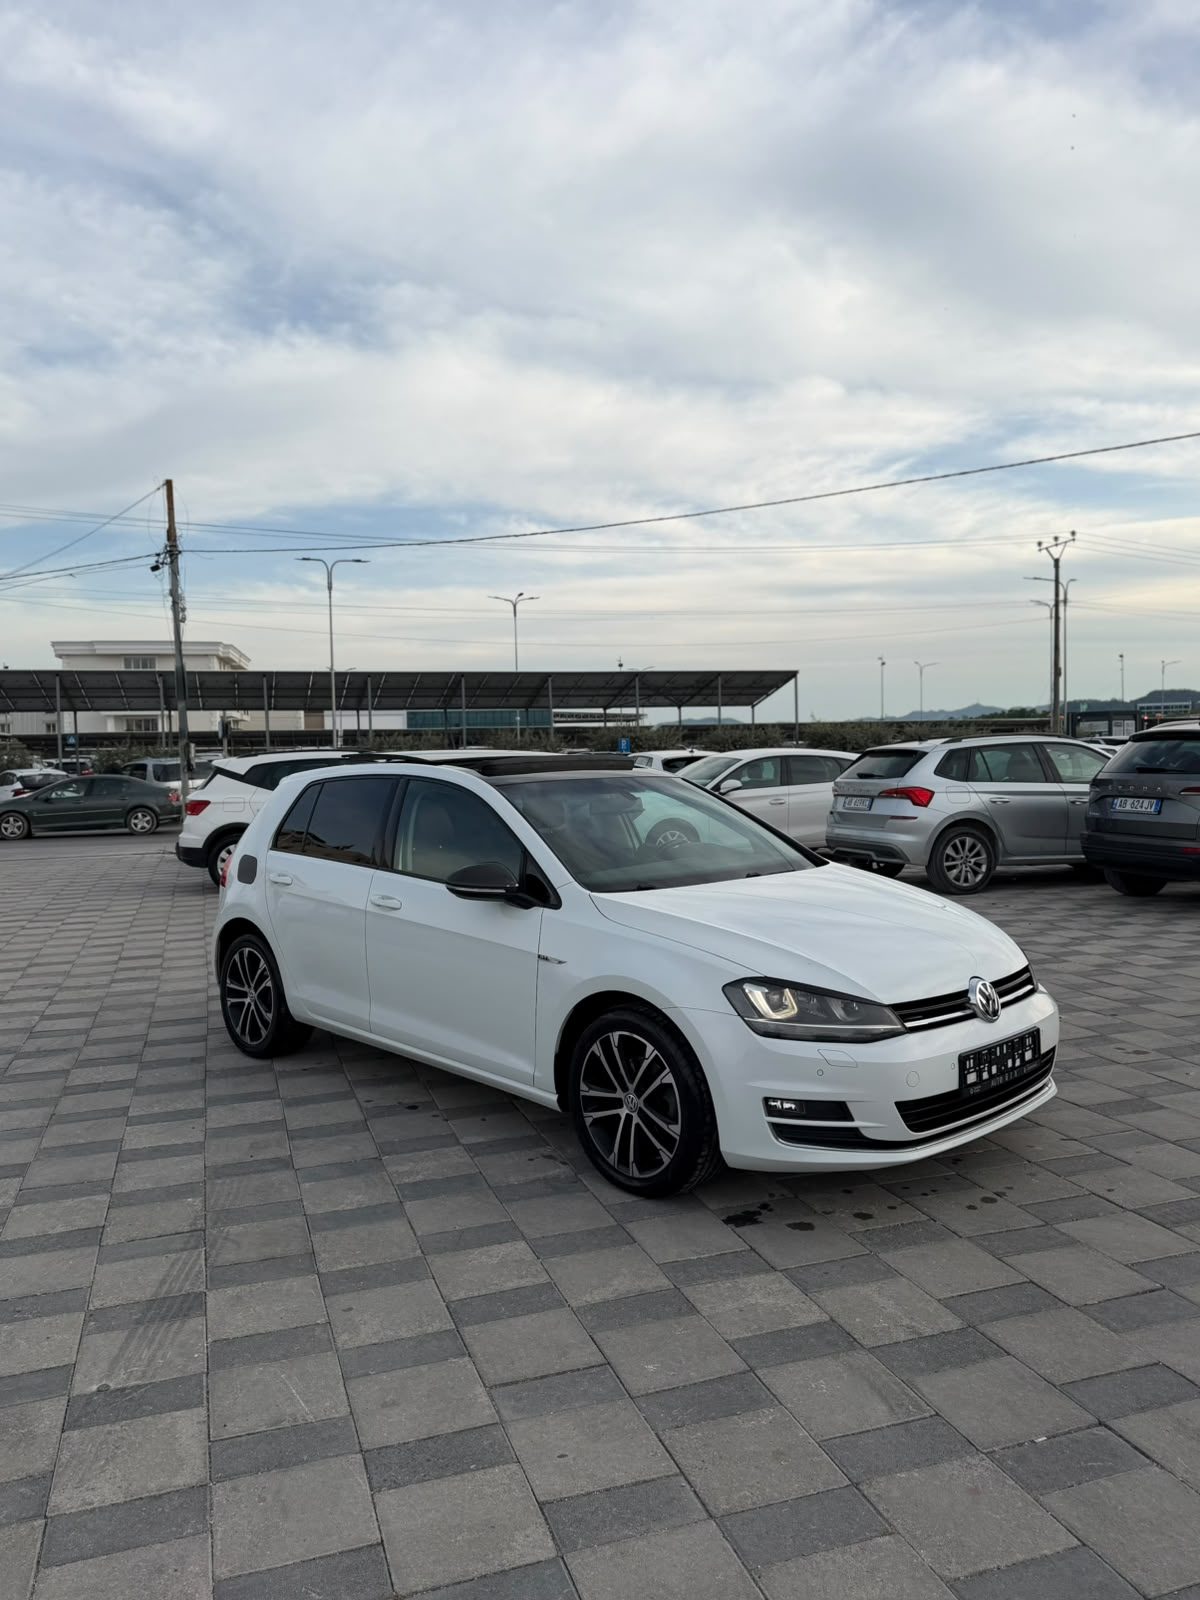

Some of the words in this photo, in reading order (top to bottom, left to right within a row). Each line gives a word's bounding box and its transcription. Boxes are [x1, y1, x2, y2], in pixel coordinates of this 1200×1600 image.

[1118, 798, 1128, 809] AB
[1130, 799, 1144, 810] 624
[1144, 800, 1155, 810] JV
